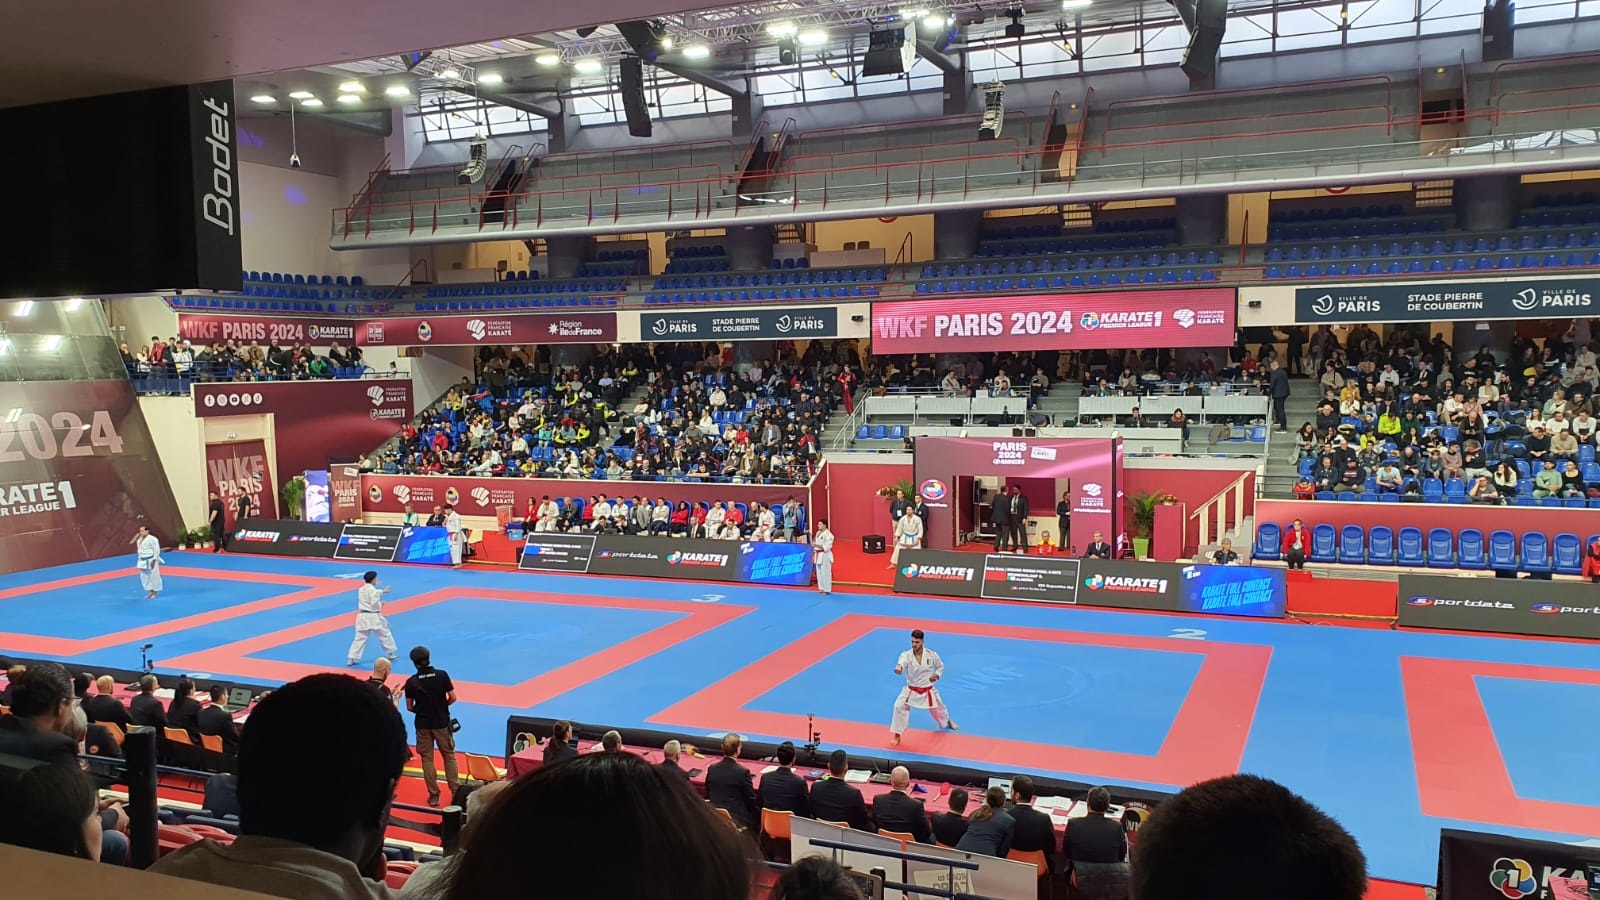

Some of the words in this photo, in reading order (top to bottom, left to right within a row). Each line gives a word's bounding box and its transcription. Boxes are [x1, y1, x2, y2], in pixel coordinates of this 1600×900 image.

[203, 98, 233, 236] Bodet
[1408, 293, 1442, 302] STADE
[1444, 292, 1483, 301] PIERRE
[1542, 294, 1592, 307] PARIS
[1338, 300, 1381, 313] PARIS
[1408, 303, 1421, 311] DE
[1423, 301, 1483, 311] COUBERTIN
[183, 320, 219, 339] WKF
[222, 321, 266, 340] PARIS
[269, 323, 304, 340] 2024
[669, 323, 697, 333] PARIS
[722, 324, 760, 332] COUBERTIN
[794, 319, 824, 330] PARIS
[878, 314, 928, 340] WKF
[934, 312, 1004, 338] PARIS
[1010, 310, 1073, 335] 2024
[993, 442, 1027, 452] PARIS
[998, 451, 1022, 459] 2024
[217, 478, 263, 497] PARIS
[334, 488, 358, 497] PARIS
[12, 501, 61, 516] LEAGUE
[1167, 628, 1208, 641] 2
